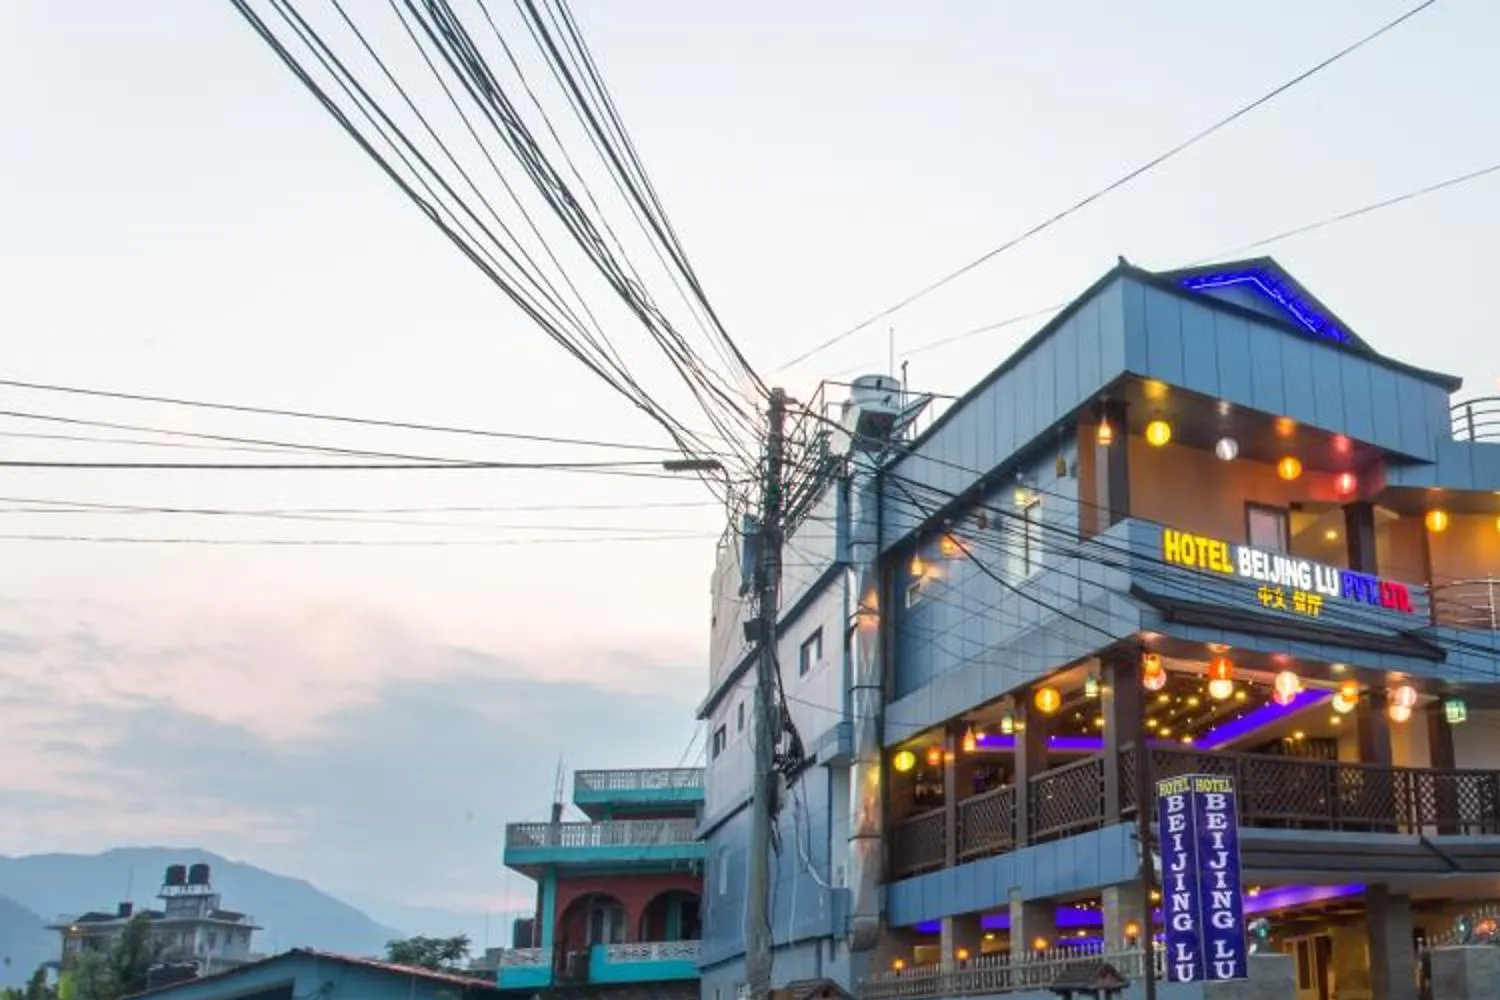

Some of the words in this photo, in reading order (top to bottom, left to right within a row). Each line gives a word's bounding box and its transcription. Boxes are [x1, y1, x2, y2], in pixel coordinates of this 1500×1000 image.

[1163, 528, 1233, 573] HOTEL
[1236, 547, 1311, 591] BEIJING
[1313, 563, 1339, 597] LU
[1159, 778, 1190, 797] HOTEL
[1195, 777, 1233, 793] HOTEL
[1166, 795, 1194, 932] BEIJING
[1204, 793, 1236, 930] BEIJING
[1175, 943, 1196, 983] LU
[1213, 939, 1237, 979] LU
